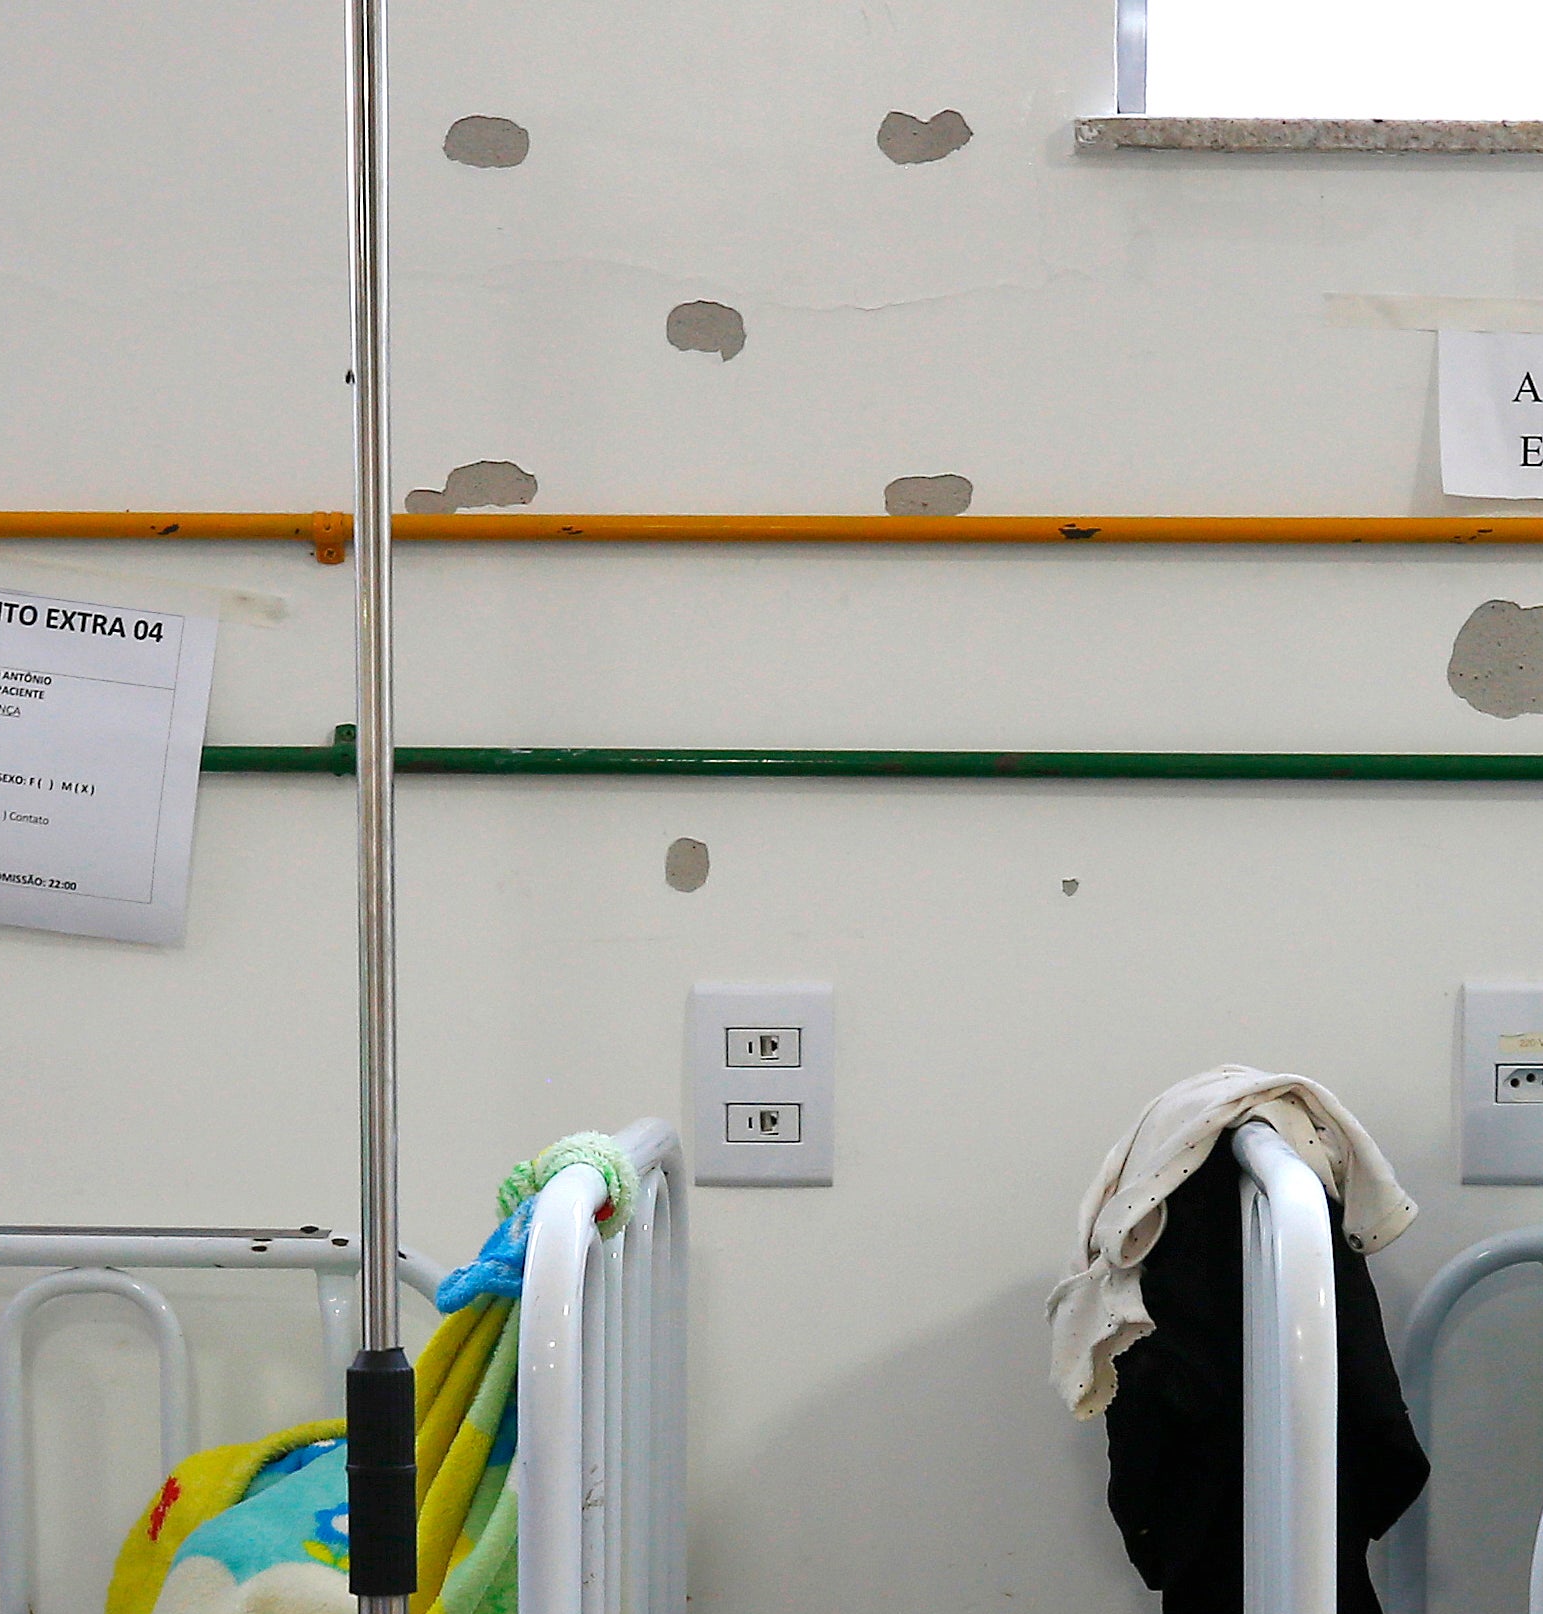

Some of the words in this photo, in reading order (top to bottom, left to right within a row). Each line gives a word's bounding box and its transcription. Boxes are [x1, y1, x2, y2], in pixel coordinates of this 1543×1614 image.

[45, 608, 126, 638] EXTRA
[133, 619, 163, 643] 04
[3, 670, 52, 686] ANTÔNIO
[9, 811, 50, 826] Contato
[48, 879, 77, 892] 22:00
